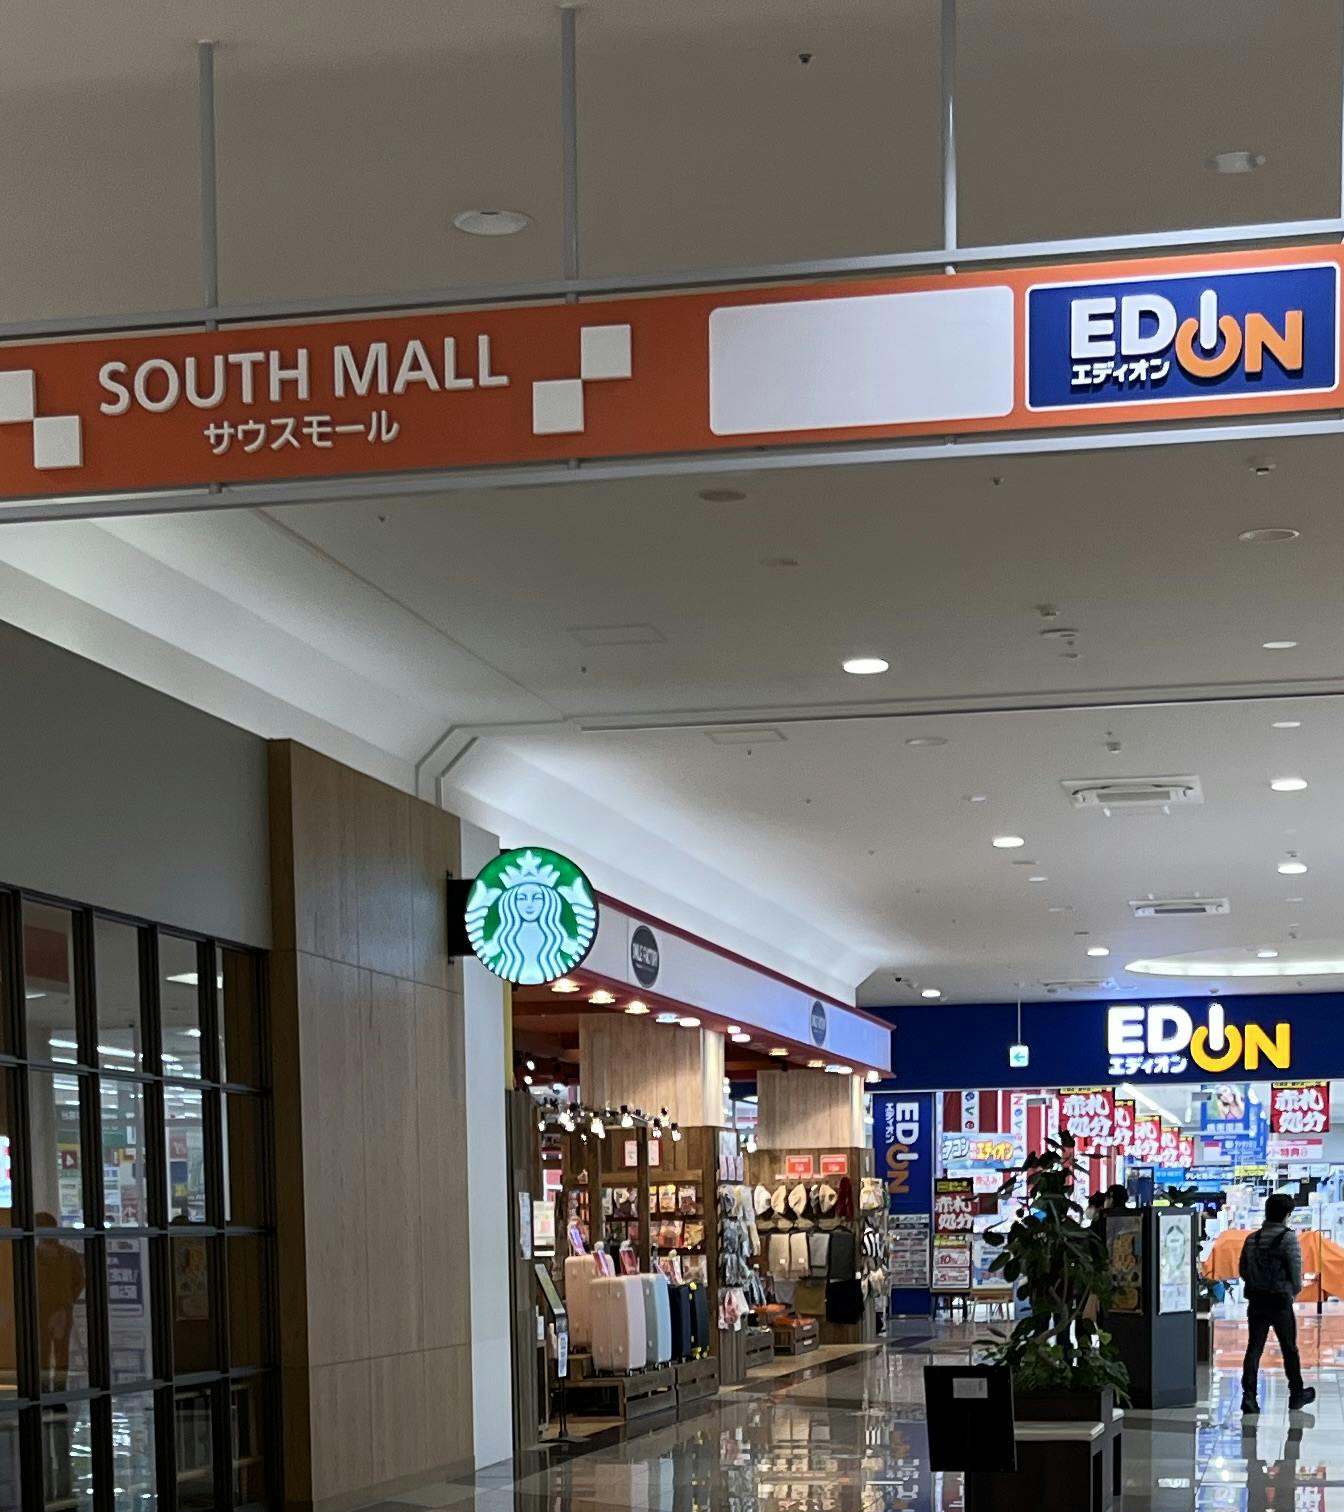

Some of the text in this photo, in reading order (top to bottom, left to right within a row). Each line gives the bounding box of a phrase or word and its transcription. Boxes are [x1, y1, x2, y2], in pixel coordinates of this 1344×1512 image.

[1070, 289, 1304, 378] EDION
[99, 333, 511, 416] SOUTH MALL
[1070, 360, 1171, 387] エディオン
[204, 409, 401, 456] サウスモール
[1106, 1002, 1291, 1072] EDION
[1108, 1056, 1188, 1075] エディオン
[886, 1102, 919, 1194] EDION
